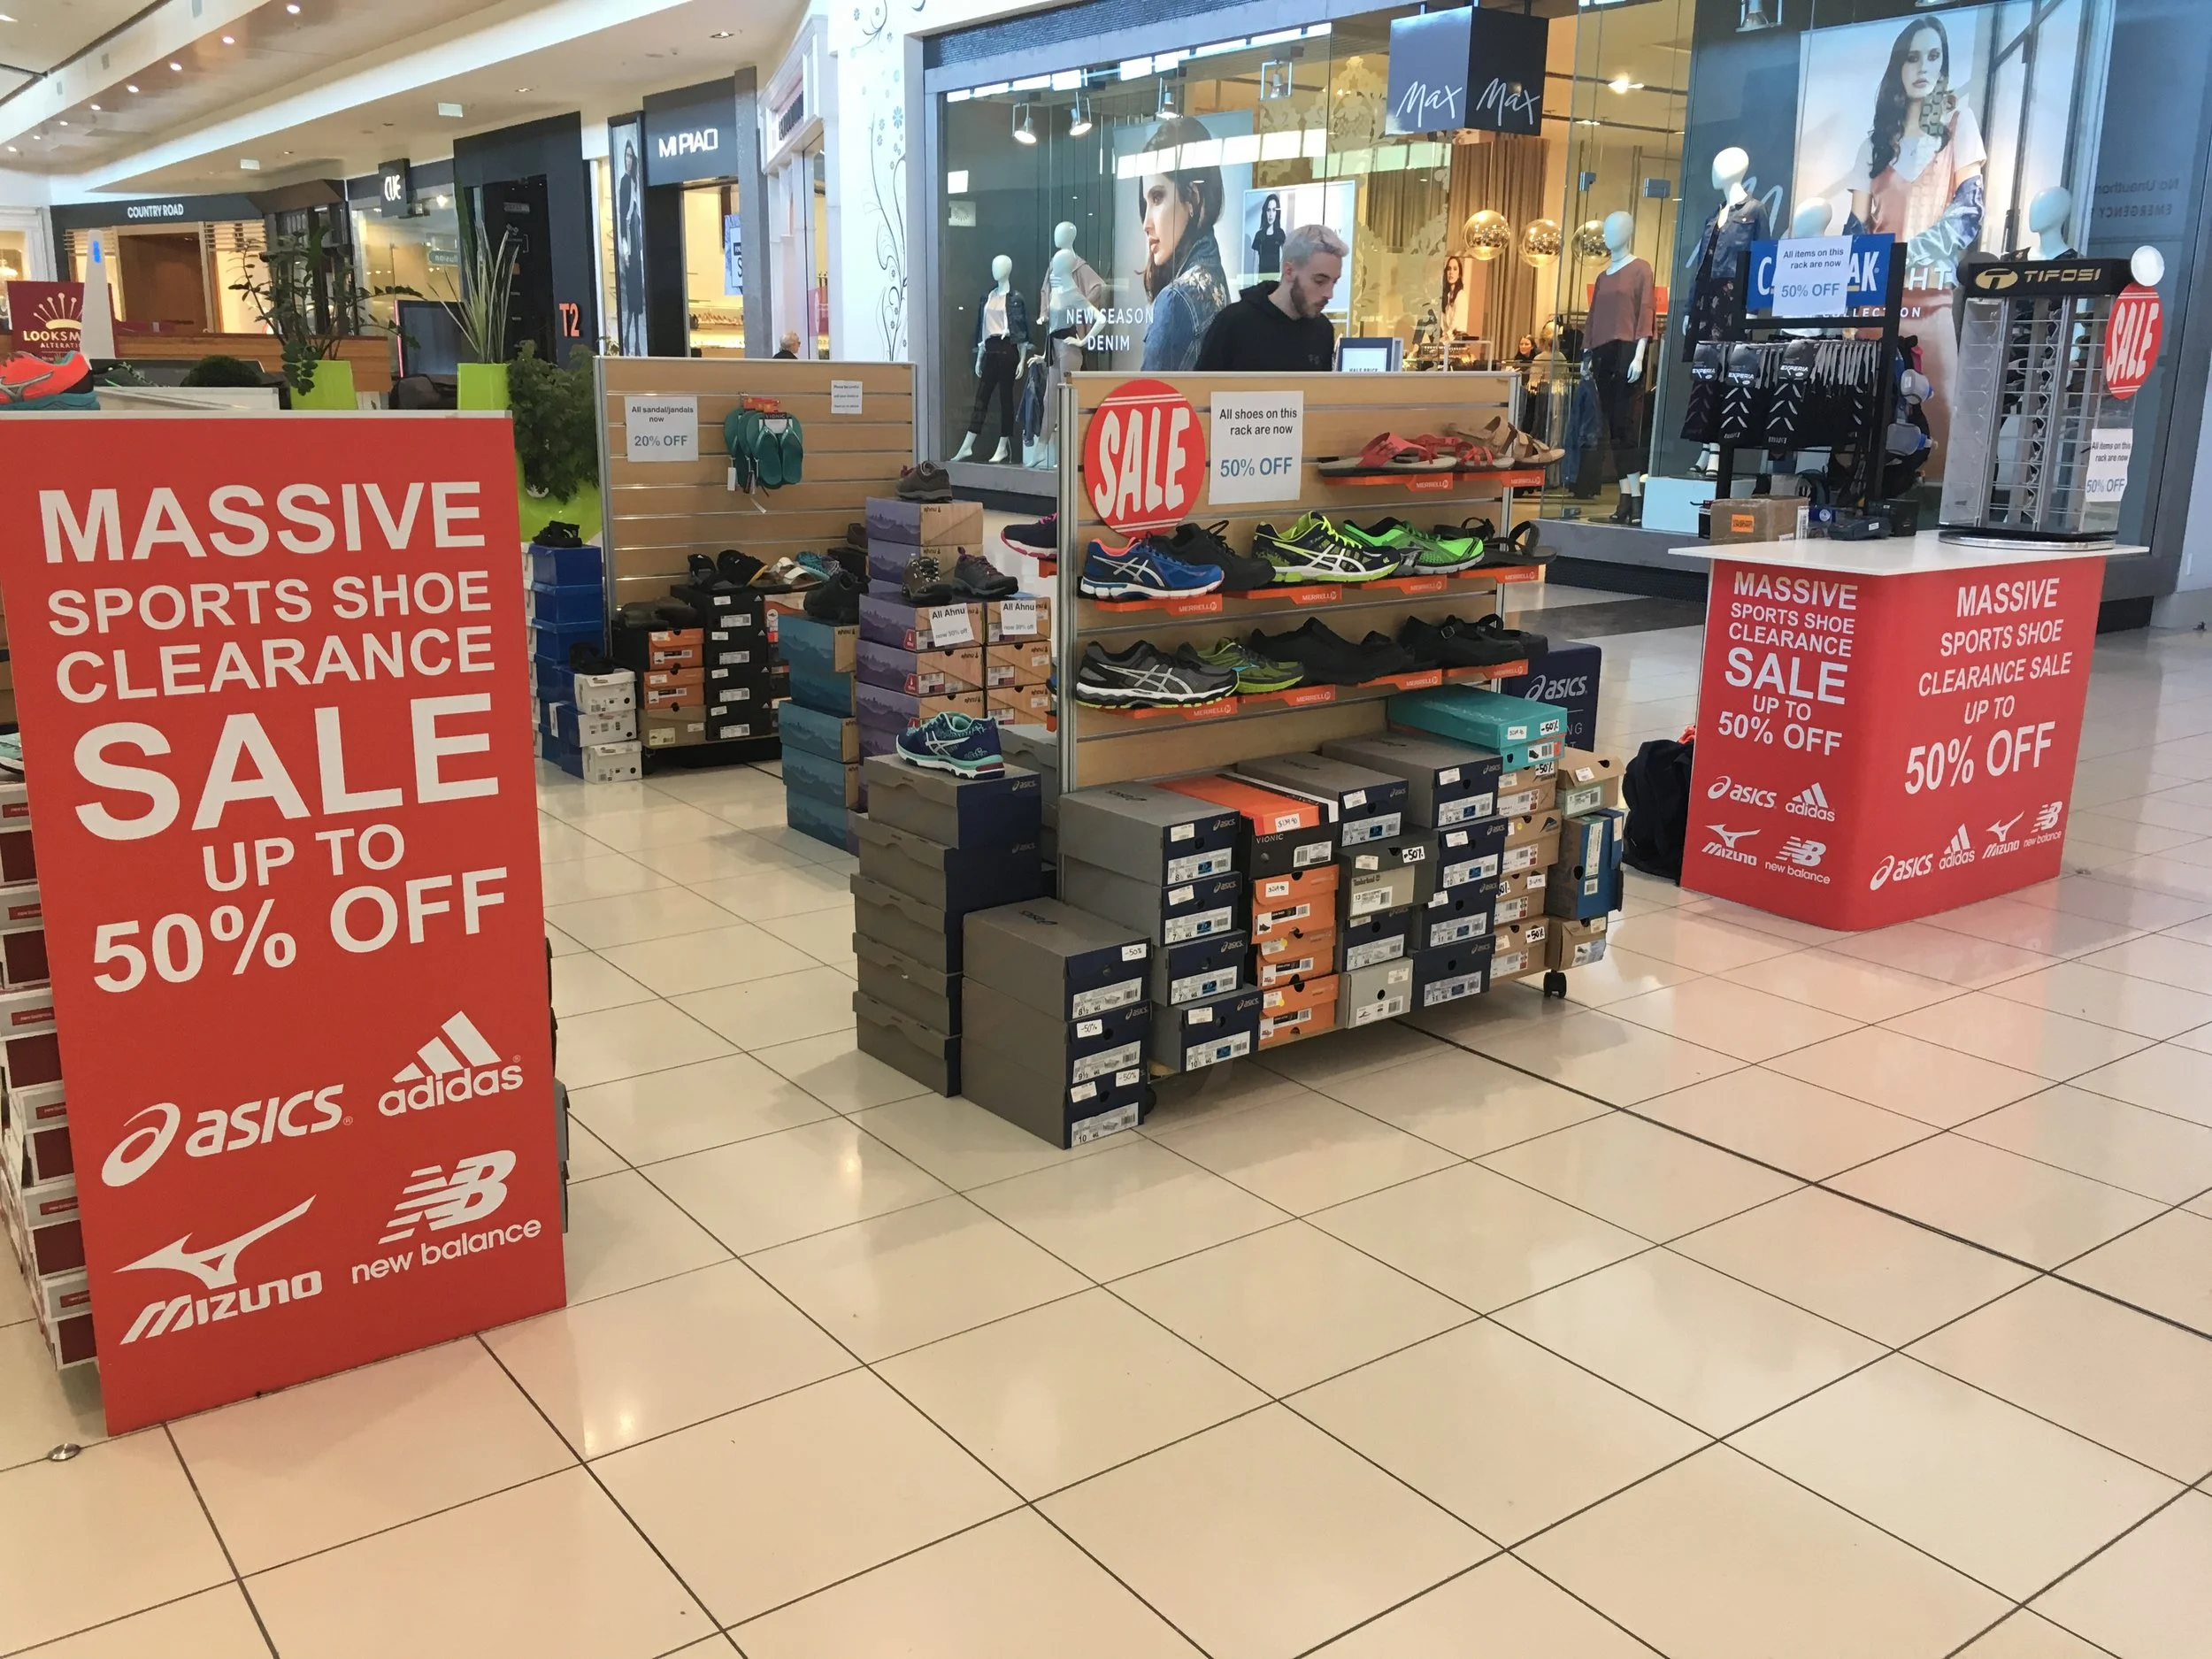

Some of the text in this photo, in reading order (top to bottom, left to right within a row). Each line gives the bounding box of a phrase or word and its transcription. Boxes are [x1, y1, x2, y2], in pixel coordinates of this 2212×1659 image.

[384, 174, 402, 201] CUE
[127, 204, 184, 219] COUNTRY ROAD
[1783, 250, 1793, 258] All
[1794, 249, 1816, 258] items
[1829, 247, 1844, 257] this
[1791, 260, 1808, 270] rack
[2024, 268, 2102, 282] TIFOSI
[1781, 283, 1840, 297] 50% OFF
[559, 303, 580, 337] T2
[1066, 307, 1155, 325] NEW SEASON
[23, 331, 81, 342] LOOKSM
[1087, 335, 1131, 351] DENIM
[2106, 302, 2159, 385] SALE
[1780, 365, 1809, 374] EXPERIA
[1219, 407, 1297, 419] All shoes on this
[634, 434, 688, 447] 20% OFF
[1230, 424, 1252, 435] rack
[1272, 426, 1294, 434] now
[1094, 406, 1190, 521] SALE
[1220, 457, 1294, 477] 50% OFF
[2086, 478, 2125, 493] 50% OFF
[39, 481, 485, 564] MASSIVE
[48, 570, 492, 636] SPORTS SHOE
[1733, 571, 1858, 611] MASSIVE
[1956, 578, 2060, 618] MASSIVE
[932, 608, 965, 619] All Ahnu
[1731, 603, 1855, 634] SPORTS SHOE
[1729, 622, 1853, 657] CLEARANCE
[1940, 618, 2063, 657] SPORTS SHOE
[56, 626, 495, 704] CLEARANCE
[1725, 647, 1847, 705] SALE
[1918, 651, 2072, 696] CLEARANCE SALE
[1406, 678, 1432, 687] MERRELL
[1296, 694, 1325, 703] MERRELL
[1753, 695, 1811, 721] UP TO
[1964, 695, 2015, 724] UP TO
[1194, 706, 1225, 717] MERRELL
[1717, 710, 1842, 756] 50% OFF
[73, 692, 499, 841] SALE
[1904, 721, 2055, 795] 50% OFF
[1785, 801, 1835, 822] adidas
[1256, 833, 1283, 844] VIONIC
[2024, 831, 2062, 848] new balance
[203, 824, 404, 892] UP TO
[1939, 849, 1976, 870] adidas
[1764, 861, 1831, 884] new balance
[93, 867, 508, 993] 50% OFF
[378, 1063, 524, 1118] adidas
[351, 1217, 541, 1285] new balance
